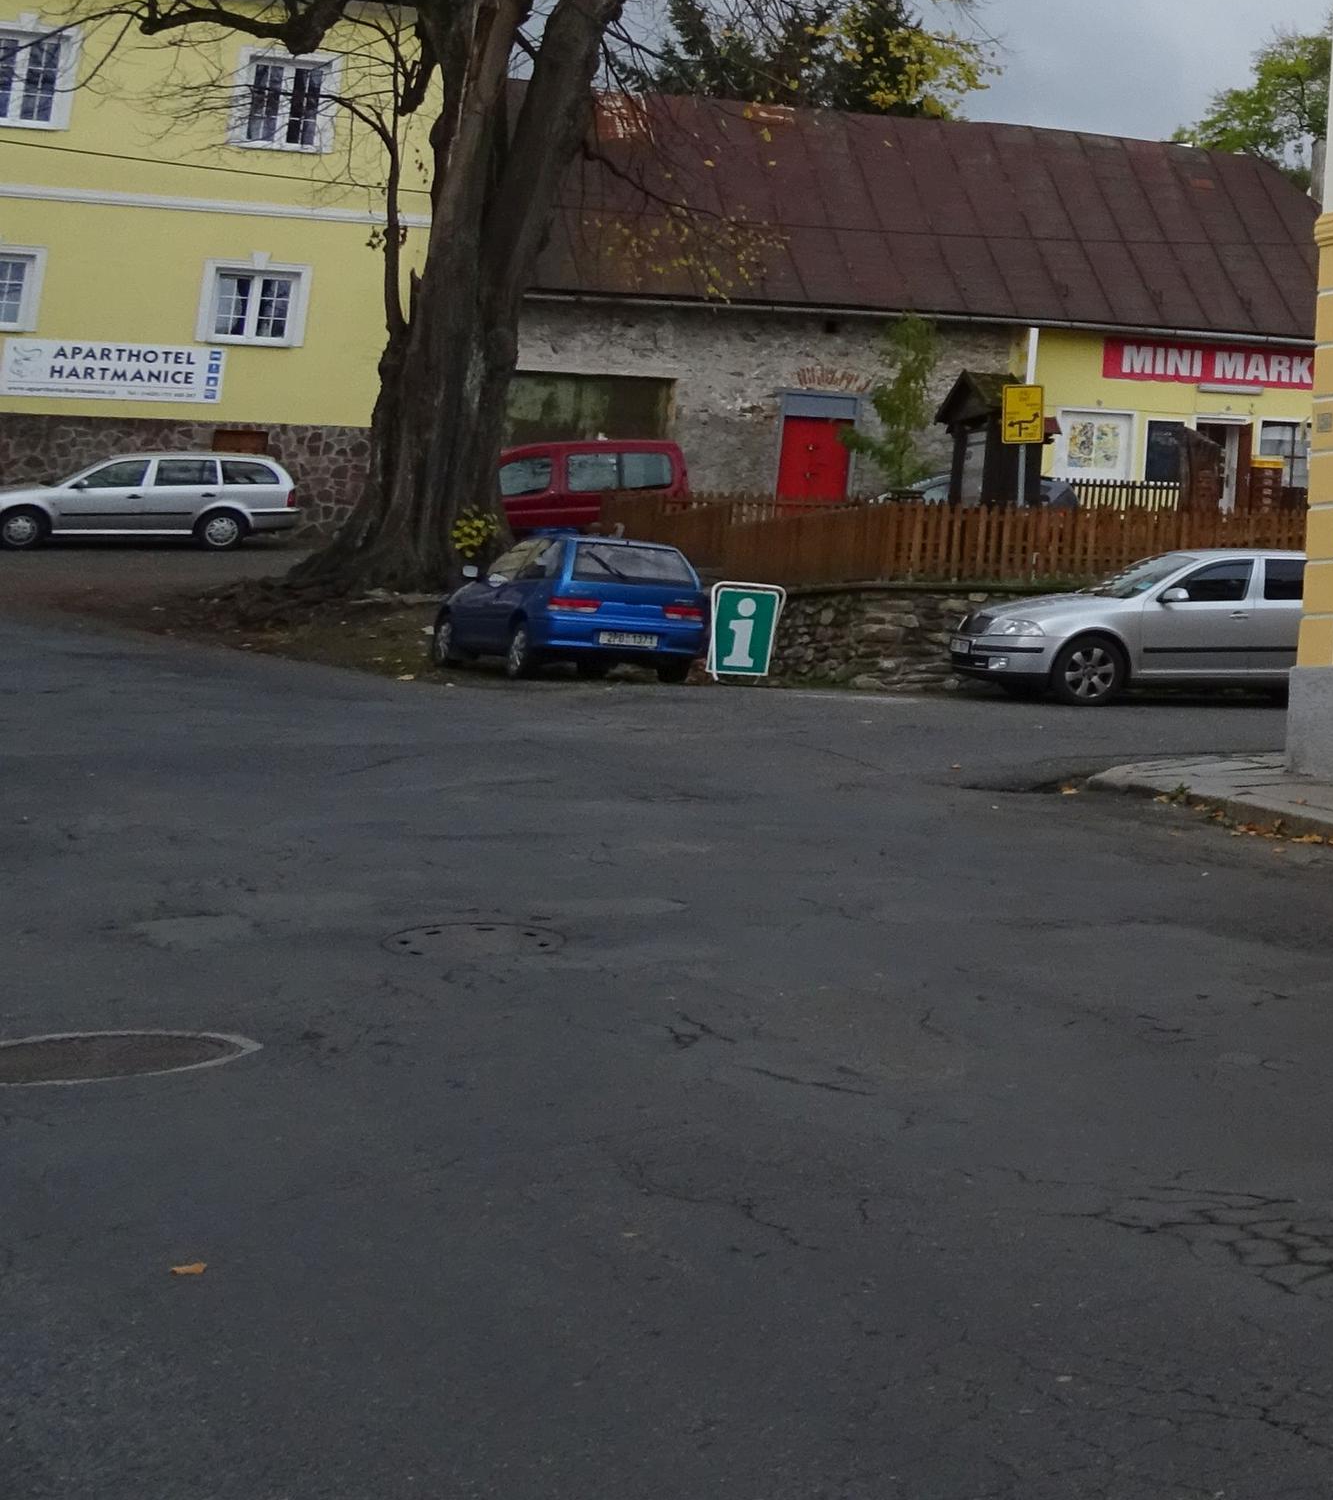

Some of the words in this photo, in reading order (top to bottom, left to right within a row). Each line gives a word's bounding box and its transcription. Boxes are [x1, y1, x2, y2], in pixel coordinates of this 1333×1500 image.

[53, 346, 197, 365] APARTHOTEL
[1121, 344, 1202, 377] MINI
[49, 364, 195, 385] HARTMANICE
